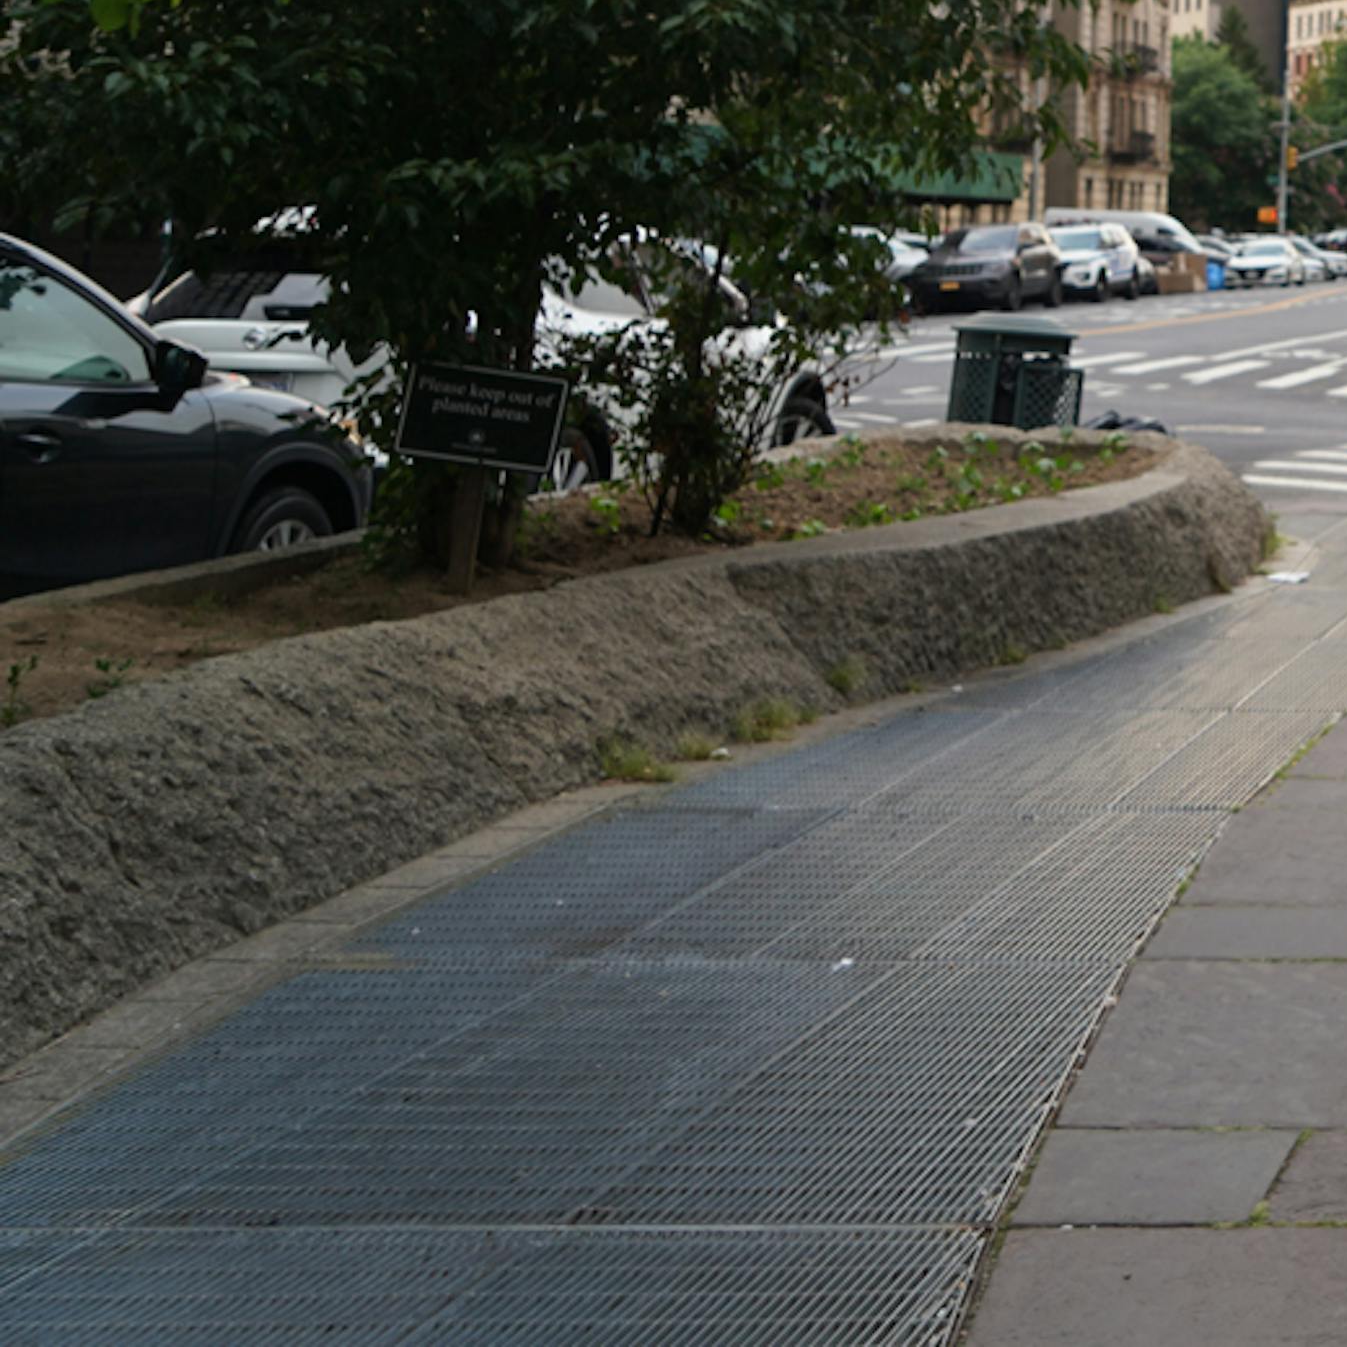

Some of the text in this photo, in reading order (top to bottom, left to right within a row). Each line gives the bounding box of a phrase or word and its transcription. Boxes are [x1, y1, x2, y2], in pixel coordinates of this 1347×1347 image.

[418, 375, 556, 408] Please keep out of
[431, 395, 530, 423] planted areas
